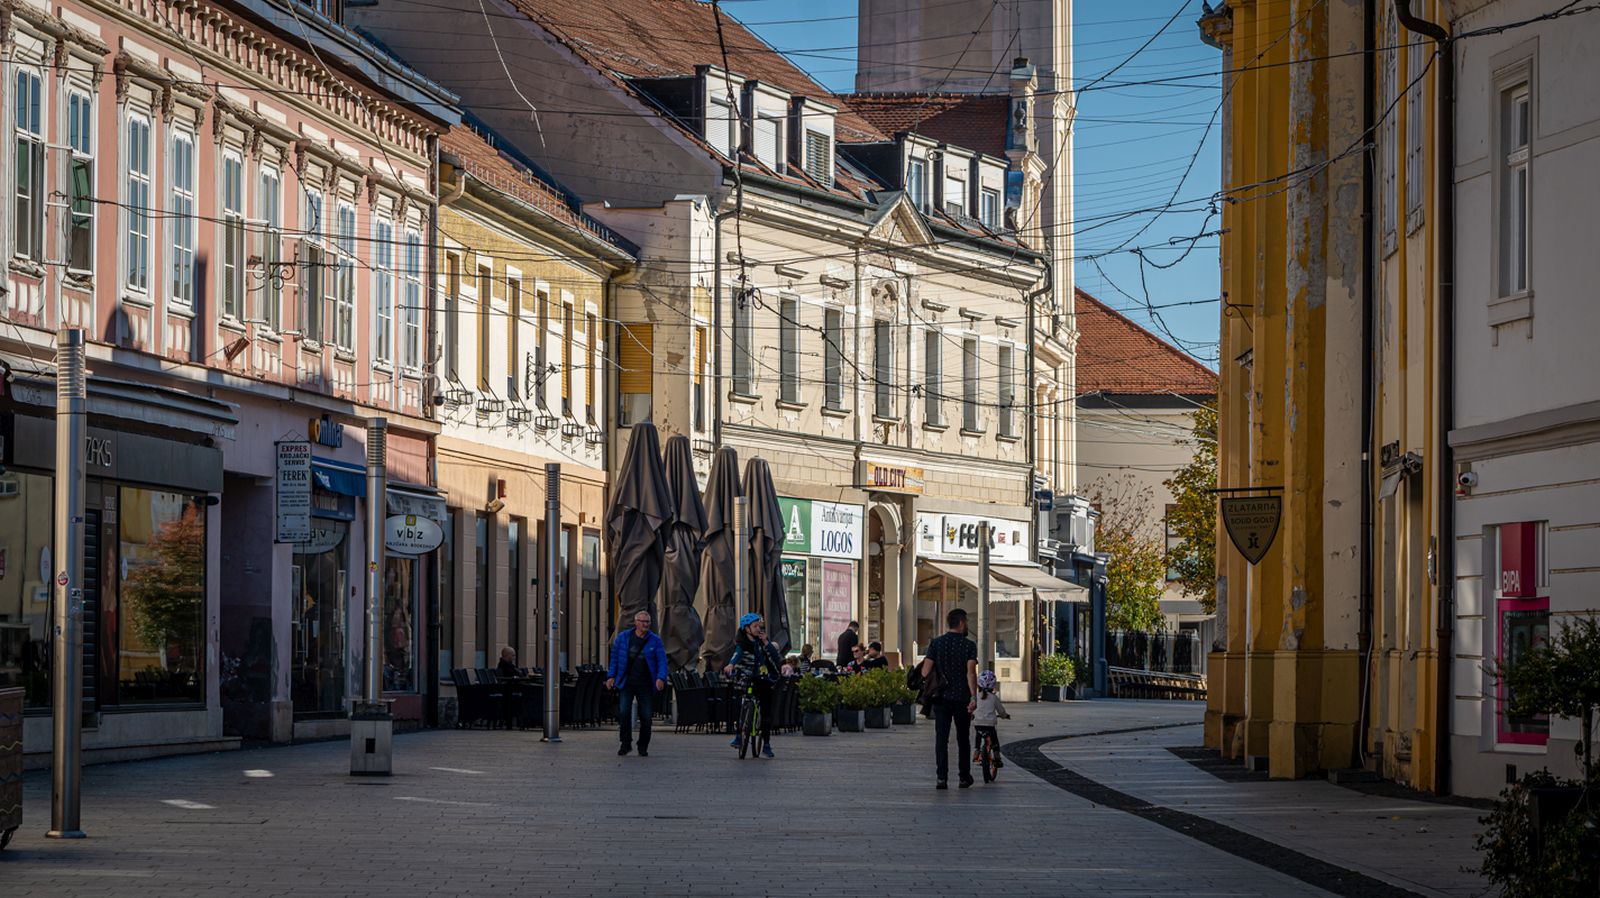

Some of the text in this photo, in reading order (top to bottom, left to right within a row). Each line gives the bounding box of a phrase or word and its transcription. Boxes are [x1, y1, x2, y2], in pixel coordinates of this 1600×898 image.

[1253, 514, 1276, 524] GOLD
[821, 530, 854, 554] LOGOS
[1503, 570, 1520, 593] BIPA
